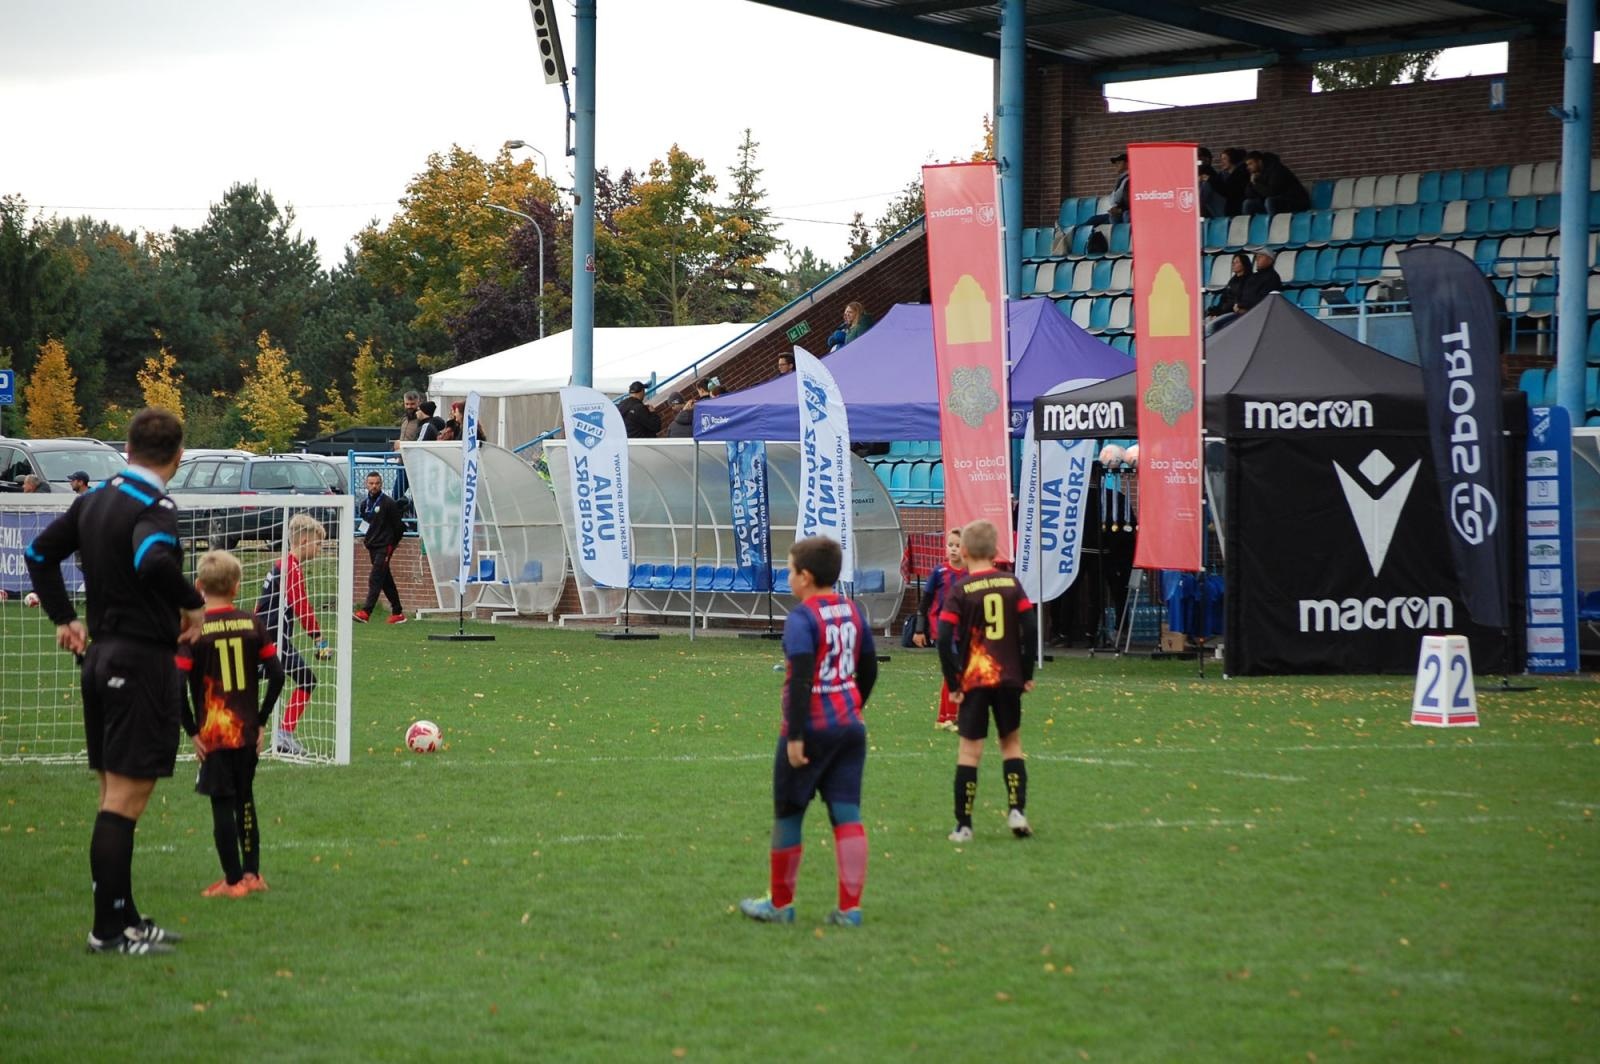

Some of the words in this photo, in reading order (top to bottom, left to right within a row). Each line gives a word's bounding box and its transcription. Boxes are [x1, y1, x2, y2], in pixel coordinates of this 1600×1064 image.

[1043, 401, 1125, 432] macron
[1244, 400, 1374, 429] macron
[1028, 453, 1039, 506] SPORTOWY
[1026, 507, 1035, 532] KLUB
[1041, 477, 1063, 551] UNIA
[1059, 456, 1086, 574] RACIBÓRZ
[1022, 533, 1032, 572] MIEJSKI
[983, 593, 1004, 640] 9
[1299, 596, 1454, 632] macron
[214, 637, 245, 692] 11
[819, 621, 857, 680] 28
[1421, 654, 1441, 707] 2
[1450, 654, 1470, 707] 2
